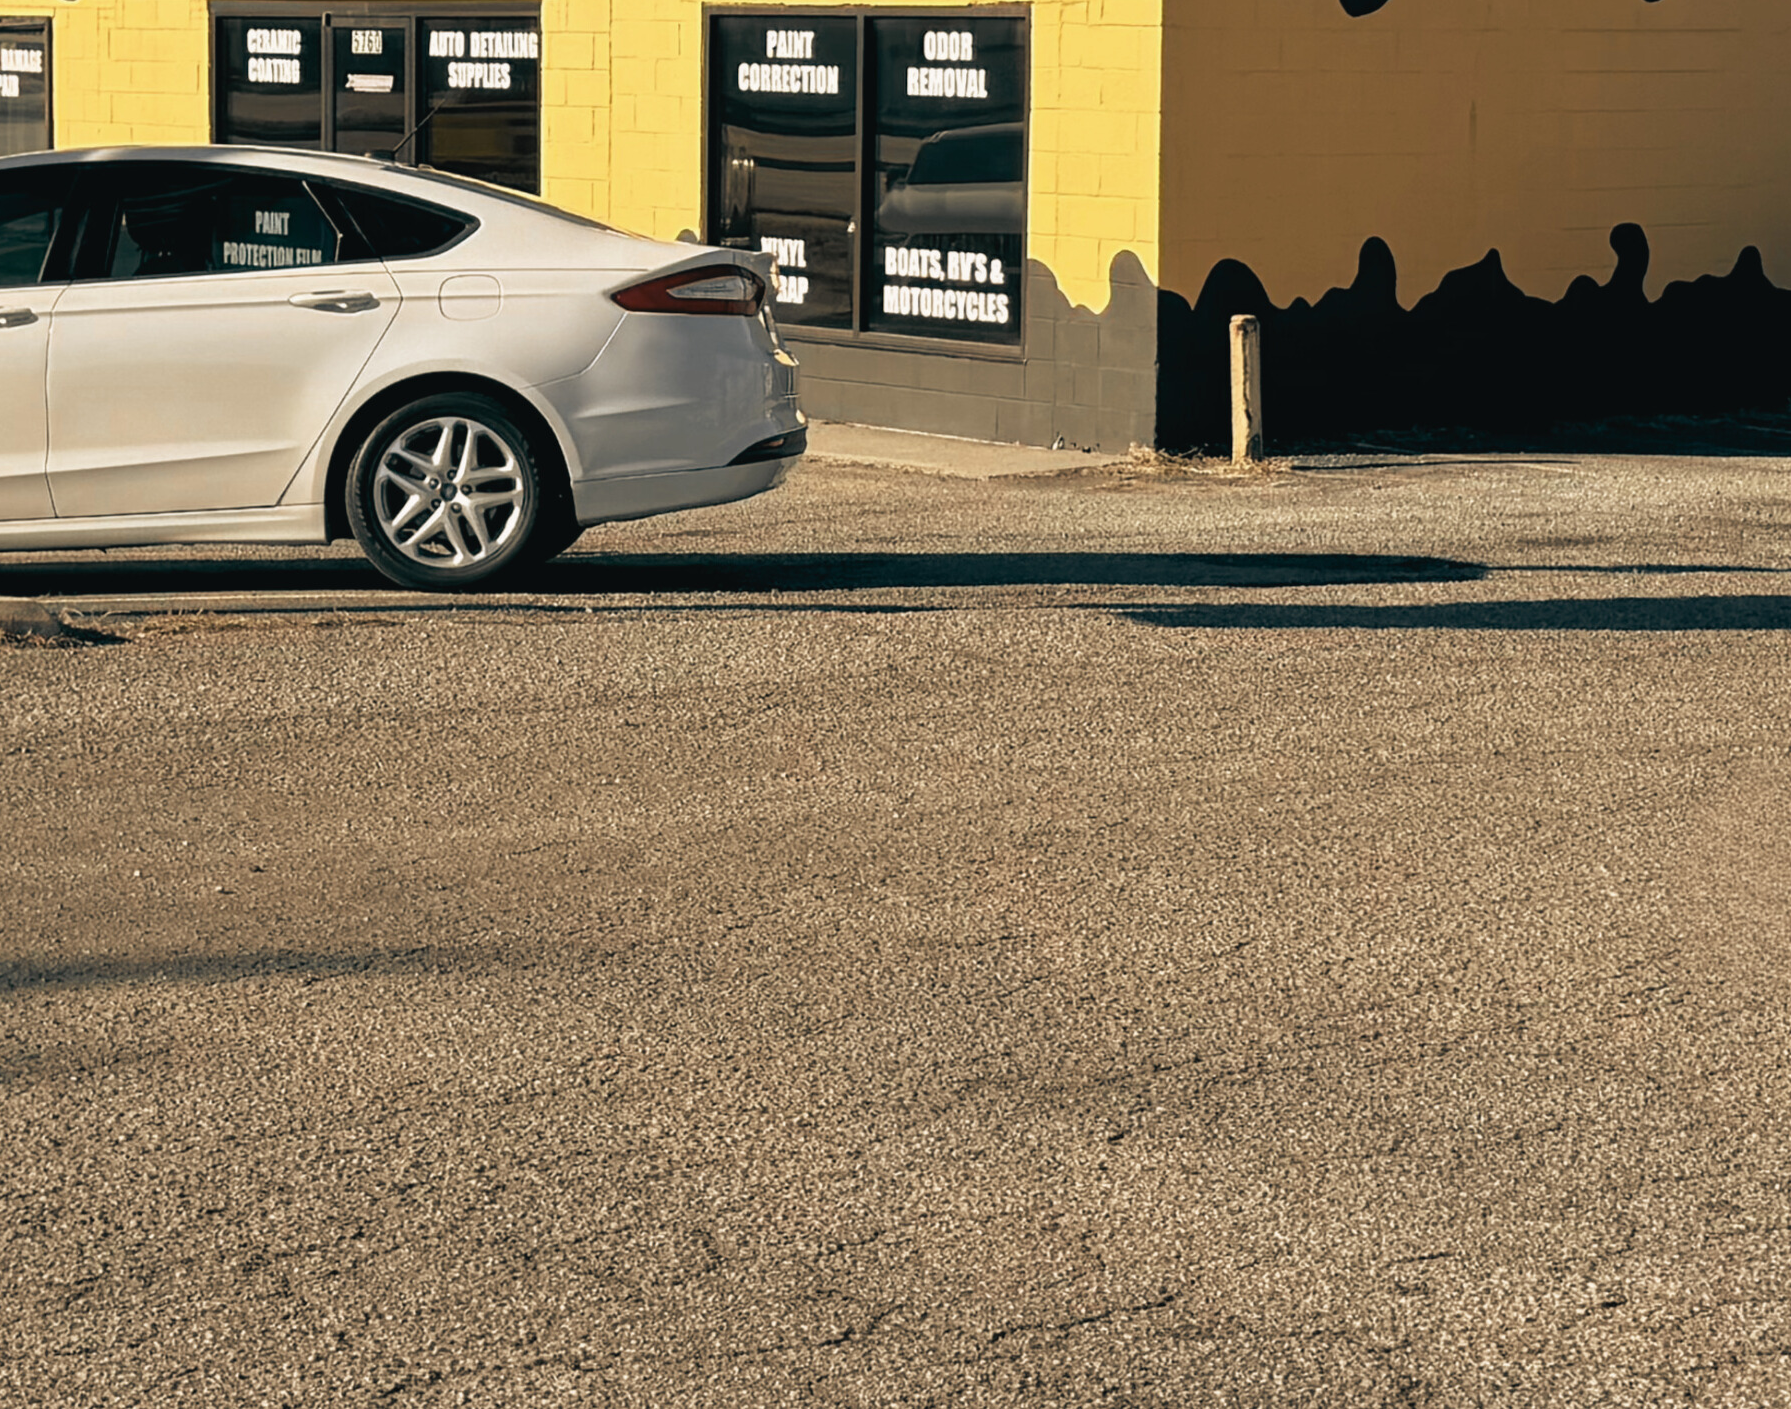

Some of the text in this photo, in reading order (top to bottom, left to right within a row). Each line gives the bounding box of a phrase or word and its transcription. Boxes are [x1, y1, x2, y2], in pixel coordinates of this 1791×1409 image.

[247, 28, 302, 55] CERAMIC
[354, 31, 381, 53] 5760
[429, 31, 538, 58] AUTO DETAILING
[766, 30, 815, 59] PAINT
[923, 31, 973, 62] ODOR
[247, 57, 301, 84] COATING
[448, 61, 511, 89] SUPPLIES
[737, 63, 839, 95] CORRECTION
[906, 67, 988, 99] REMOVAL
[255, 210, 290, 236] PAINT
[223, 241, 294, 268] PROTECTION
[884, 246, 1005, 285] BOATS, RV'S &
[776, 275, 809, 304] RAP
[883, 285, 1009, 324] MOTORCYCLES
